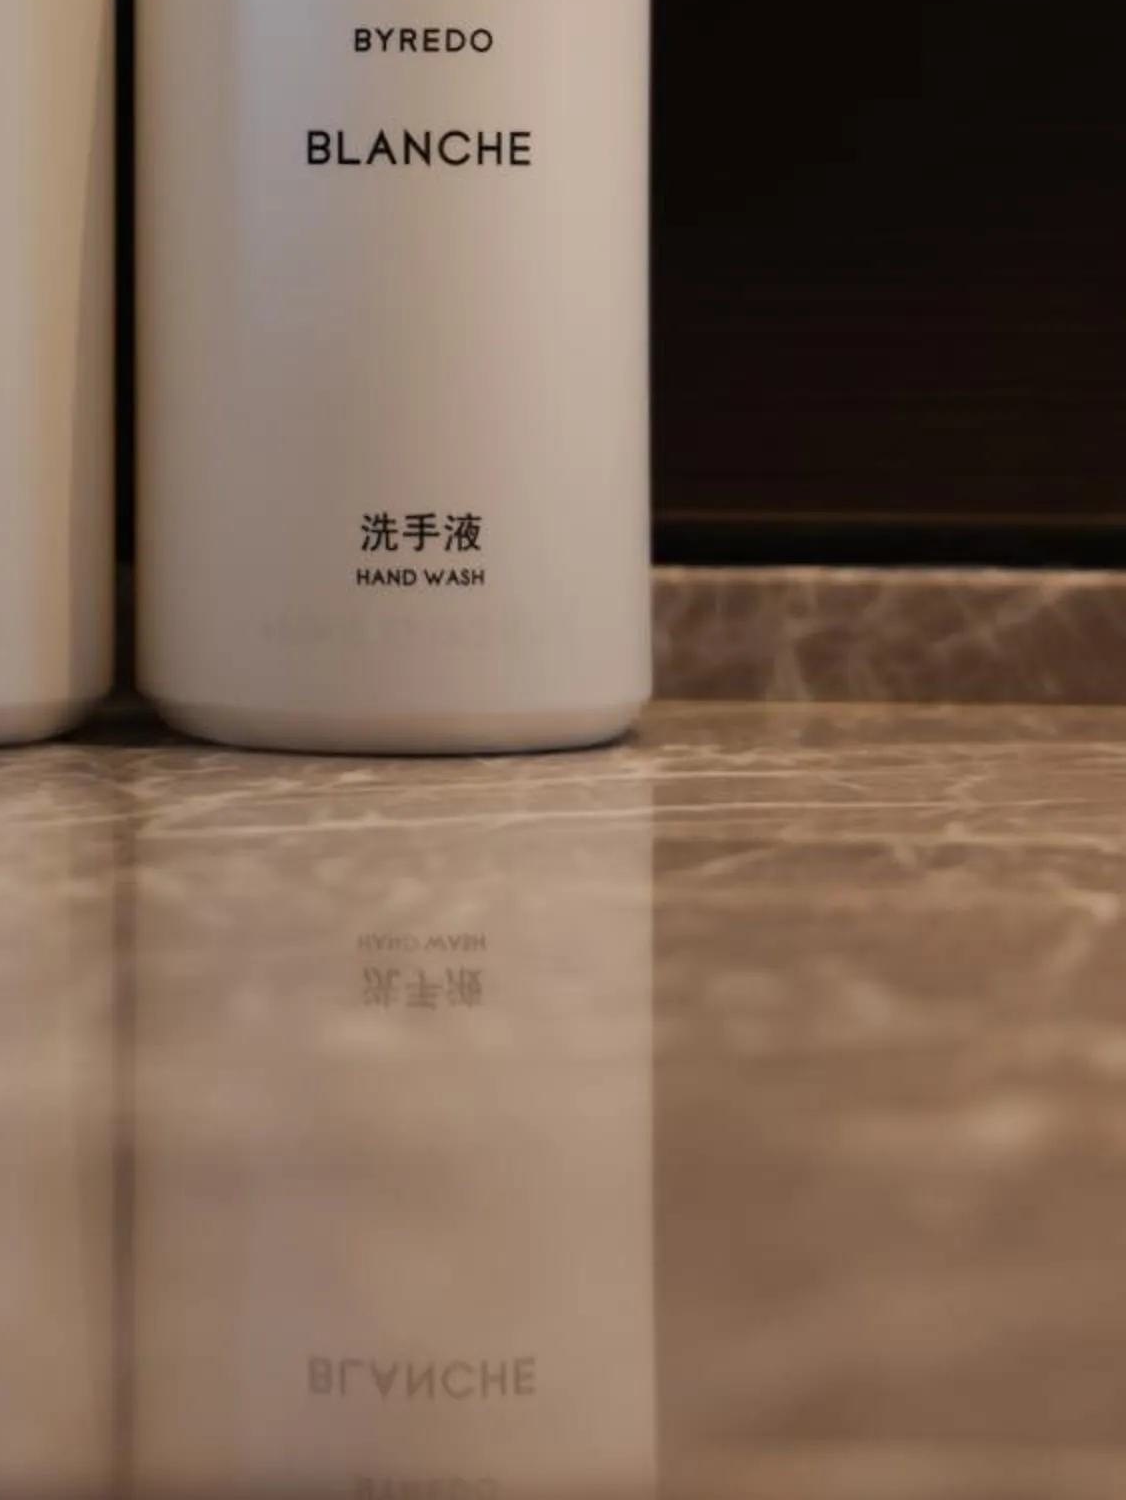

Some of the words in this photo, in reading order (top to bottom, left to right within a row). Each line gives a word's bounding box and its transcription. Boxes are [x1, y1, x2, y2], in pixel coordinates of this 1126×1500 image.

[354, 27, 494, 53] BYREDO
[307, 130, 531, 167] BLANCHE
[361, 512, 482, 552] 洗手液
[356, 568, 417, 587] HAND
[423, 568, 485, 587] WASH
